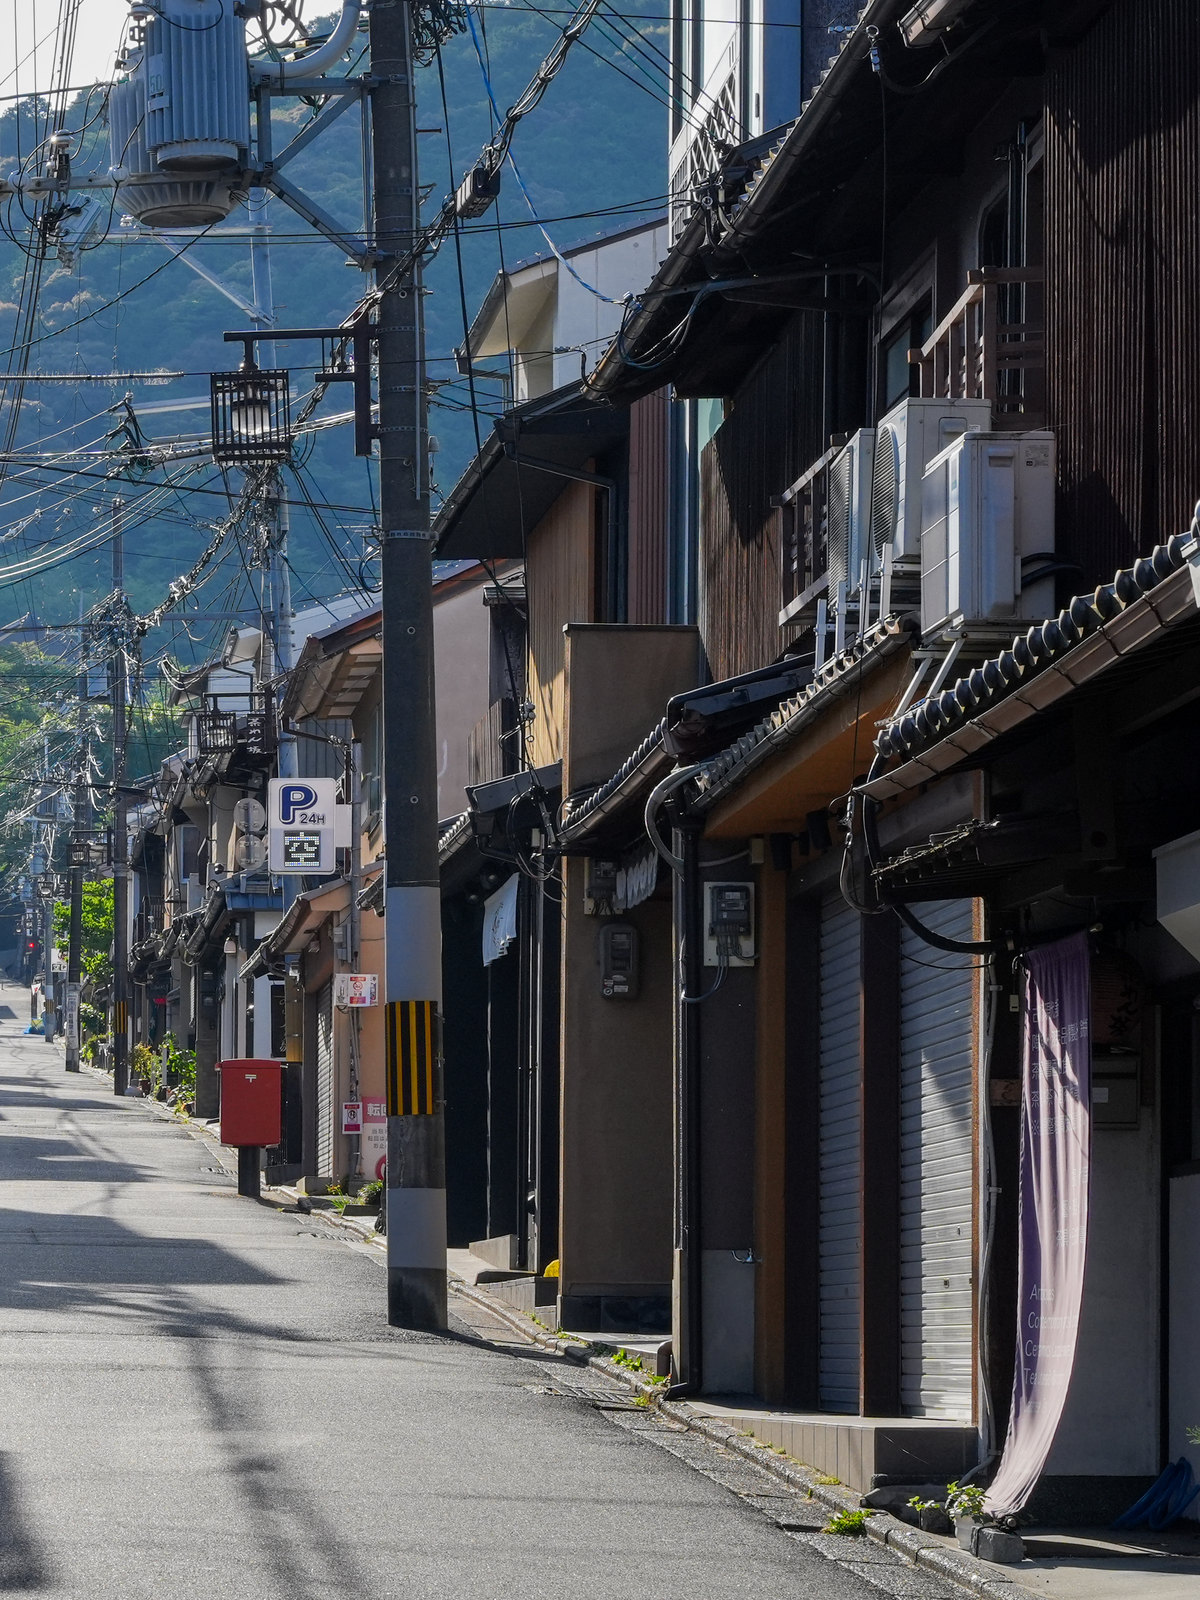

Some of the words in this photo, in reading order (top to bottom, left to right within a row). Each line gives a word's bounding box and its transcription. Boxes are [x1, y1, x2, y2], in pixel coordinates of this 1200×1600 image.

[279, 784, 318, 825] P
[299, 813, 326, 825] 24H
[284, 831, 320, 867] 空
